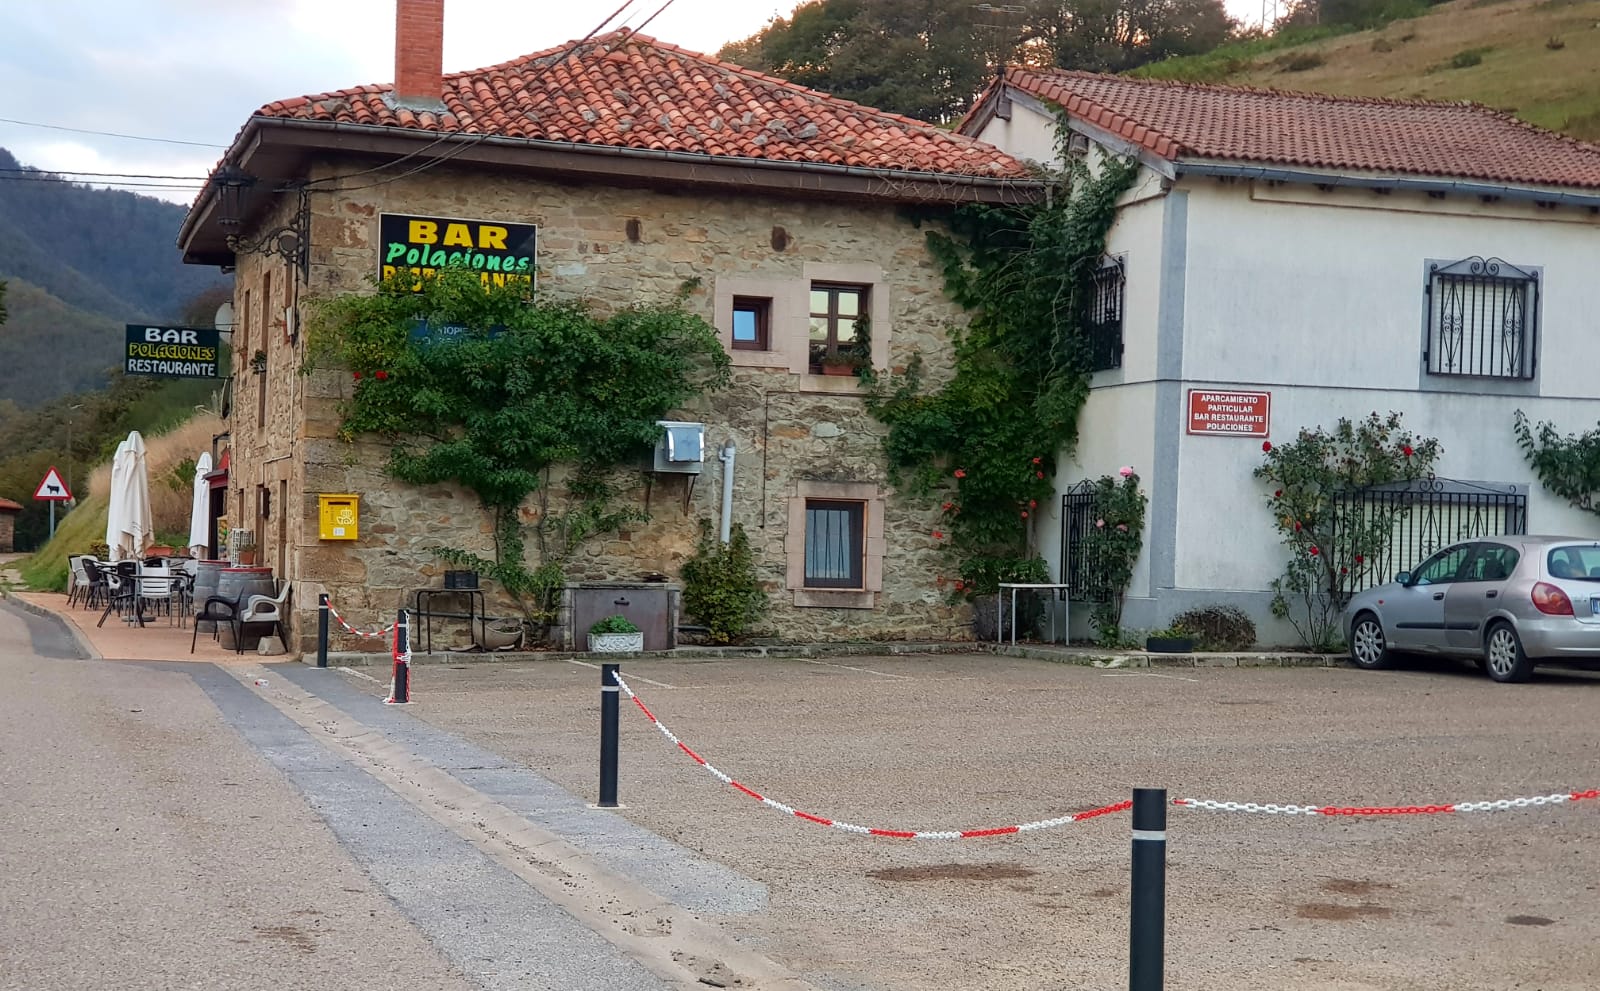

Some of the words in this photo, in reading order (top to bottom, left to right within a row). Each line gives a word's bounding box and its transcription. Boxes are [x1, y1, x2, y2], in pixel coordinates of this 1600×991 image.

[408, 220, 508, 249] BAR
[386, 242, 529, 271] Polaciones
[145, 328, 198, 344] BAR
[129, 343, 215, 360] POLACIONES
[128, 359, 215, 376] RESTAURANTE
[1201, 394, 1258, 403] APARCAMIENTO
[1208, 404, 1253, 412] PARTICULAR
[1211, 413, 1263, 422] RESTAURANTE
[1206, 423, 1253, 431] POLACIONES
